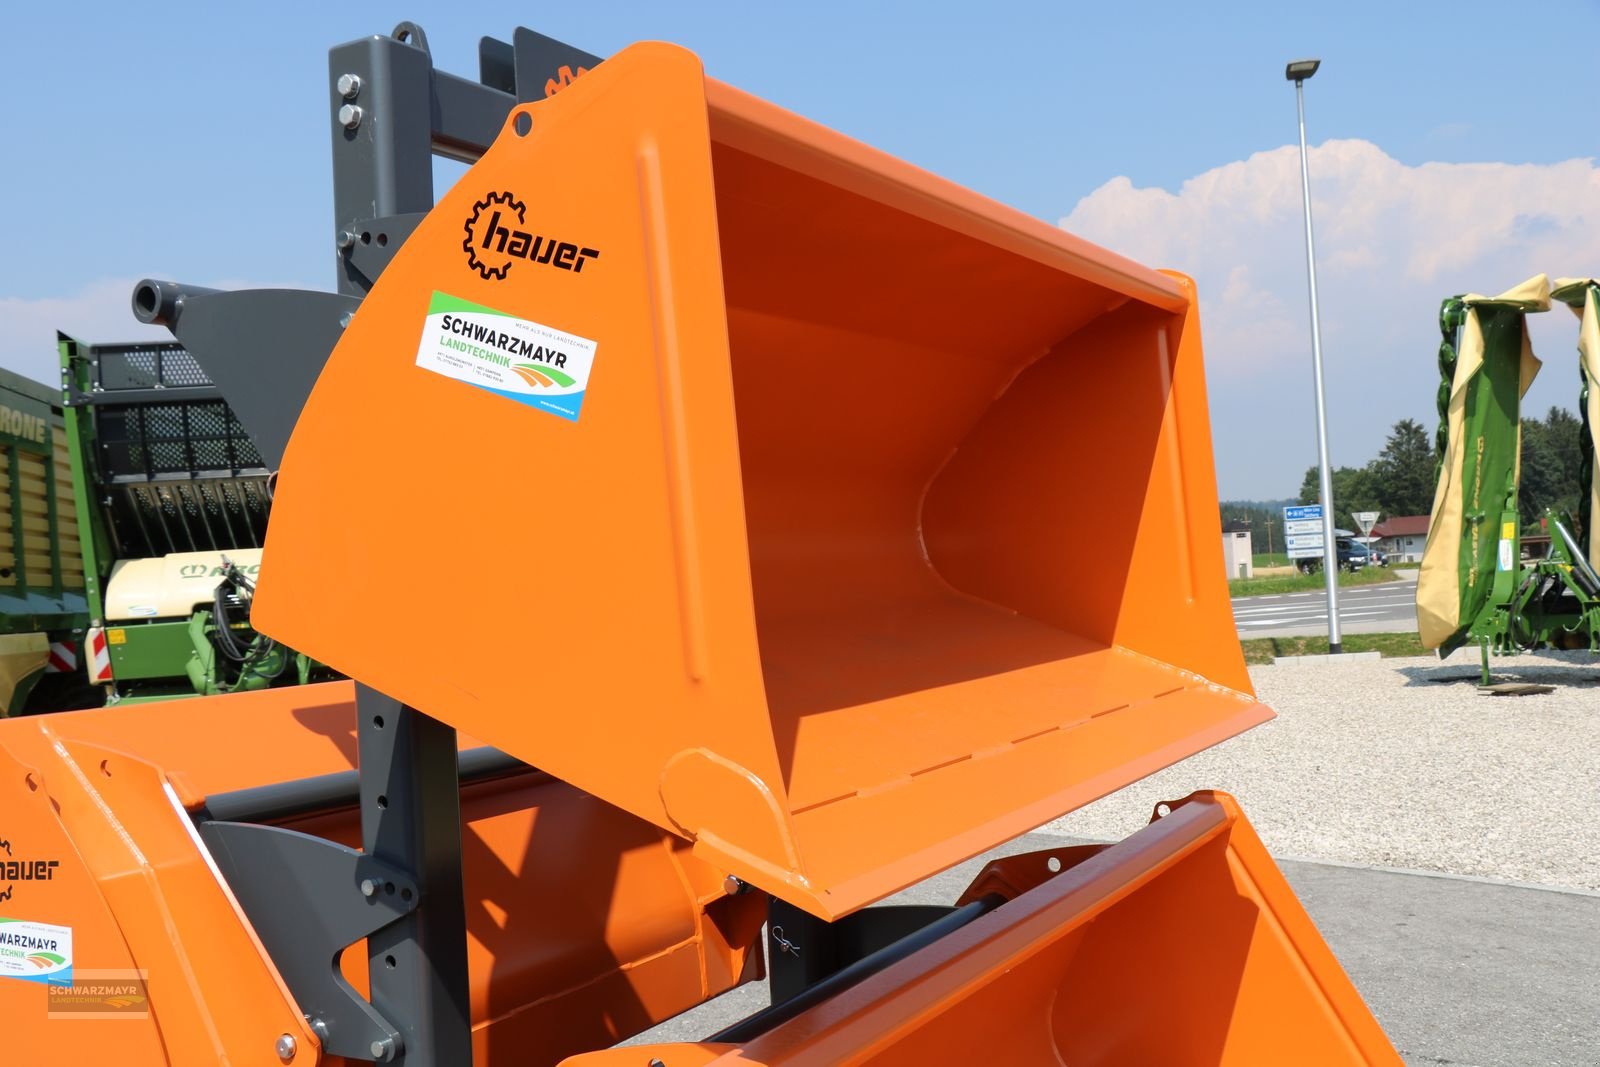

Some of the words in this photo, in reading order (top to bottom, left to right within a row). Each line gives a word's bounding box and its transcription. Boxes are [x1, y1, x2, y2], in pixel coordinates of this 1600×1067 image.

[482, 211, 600, 273] hauer
[440, 335, 512, 368] LANDTECHNIK
[441, 314, 568, 369] SCHWARZMAYR
